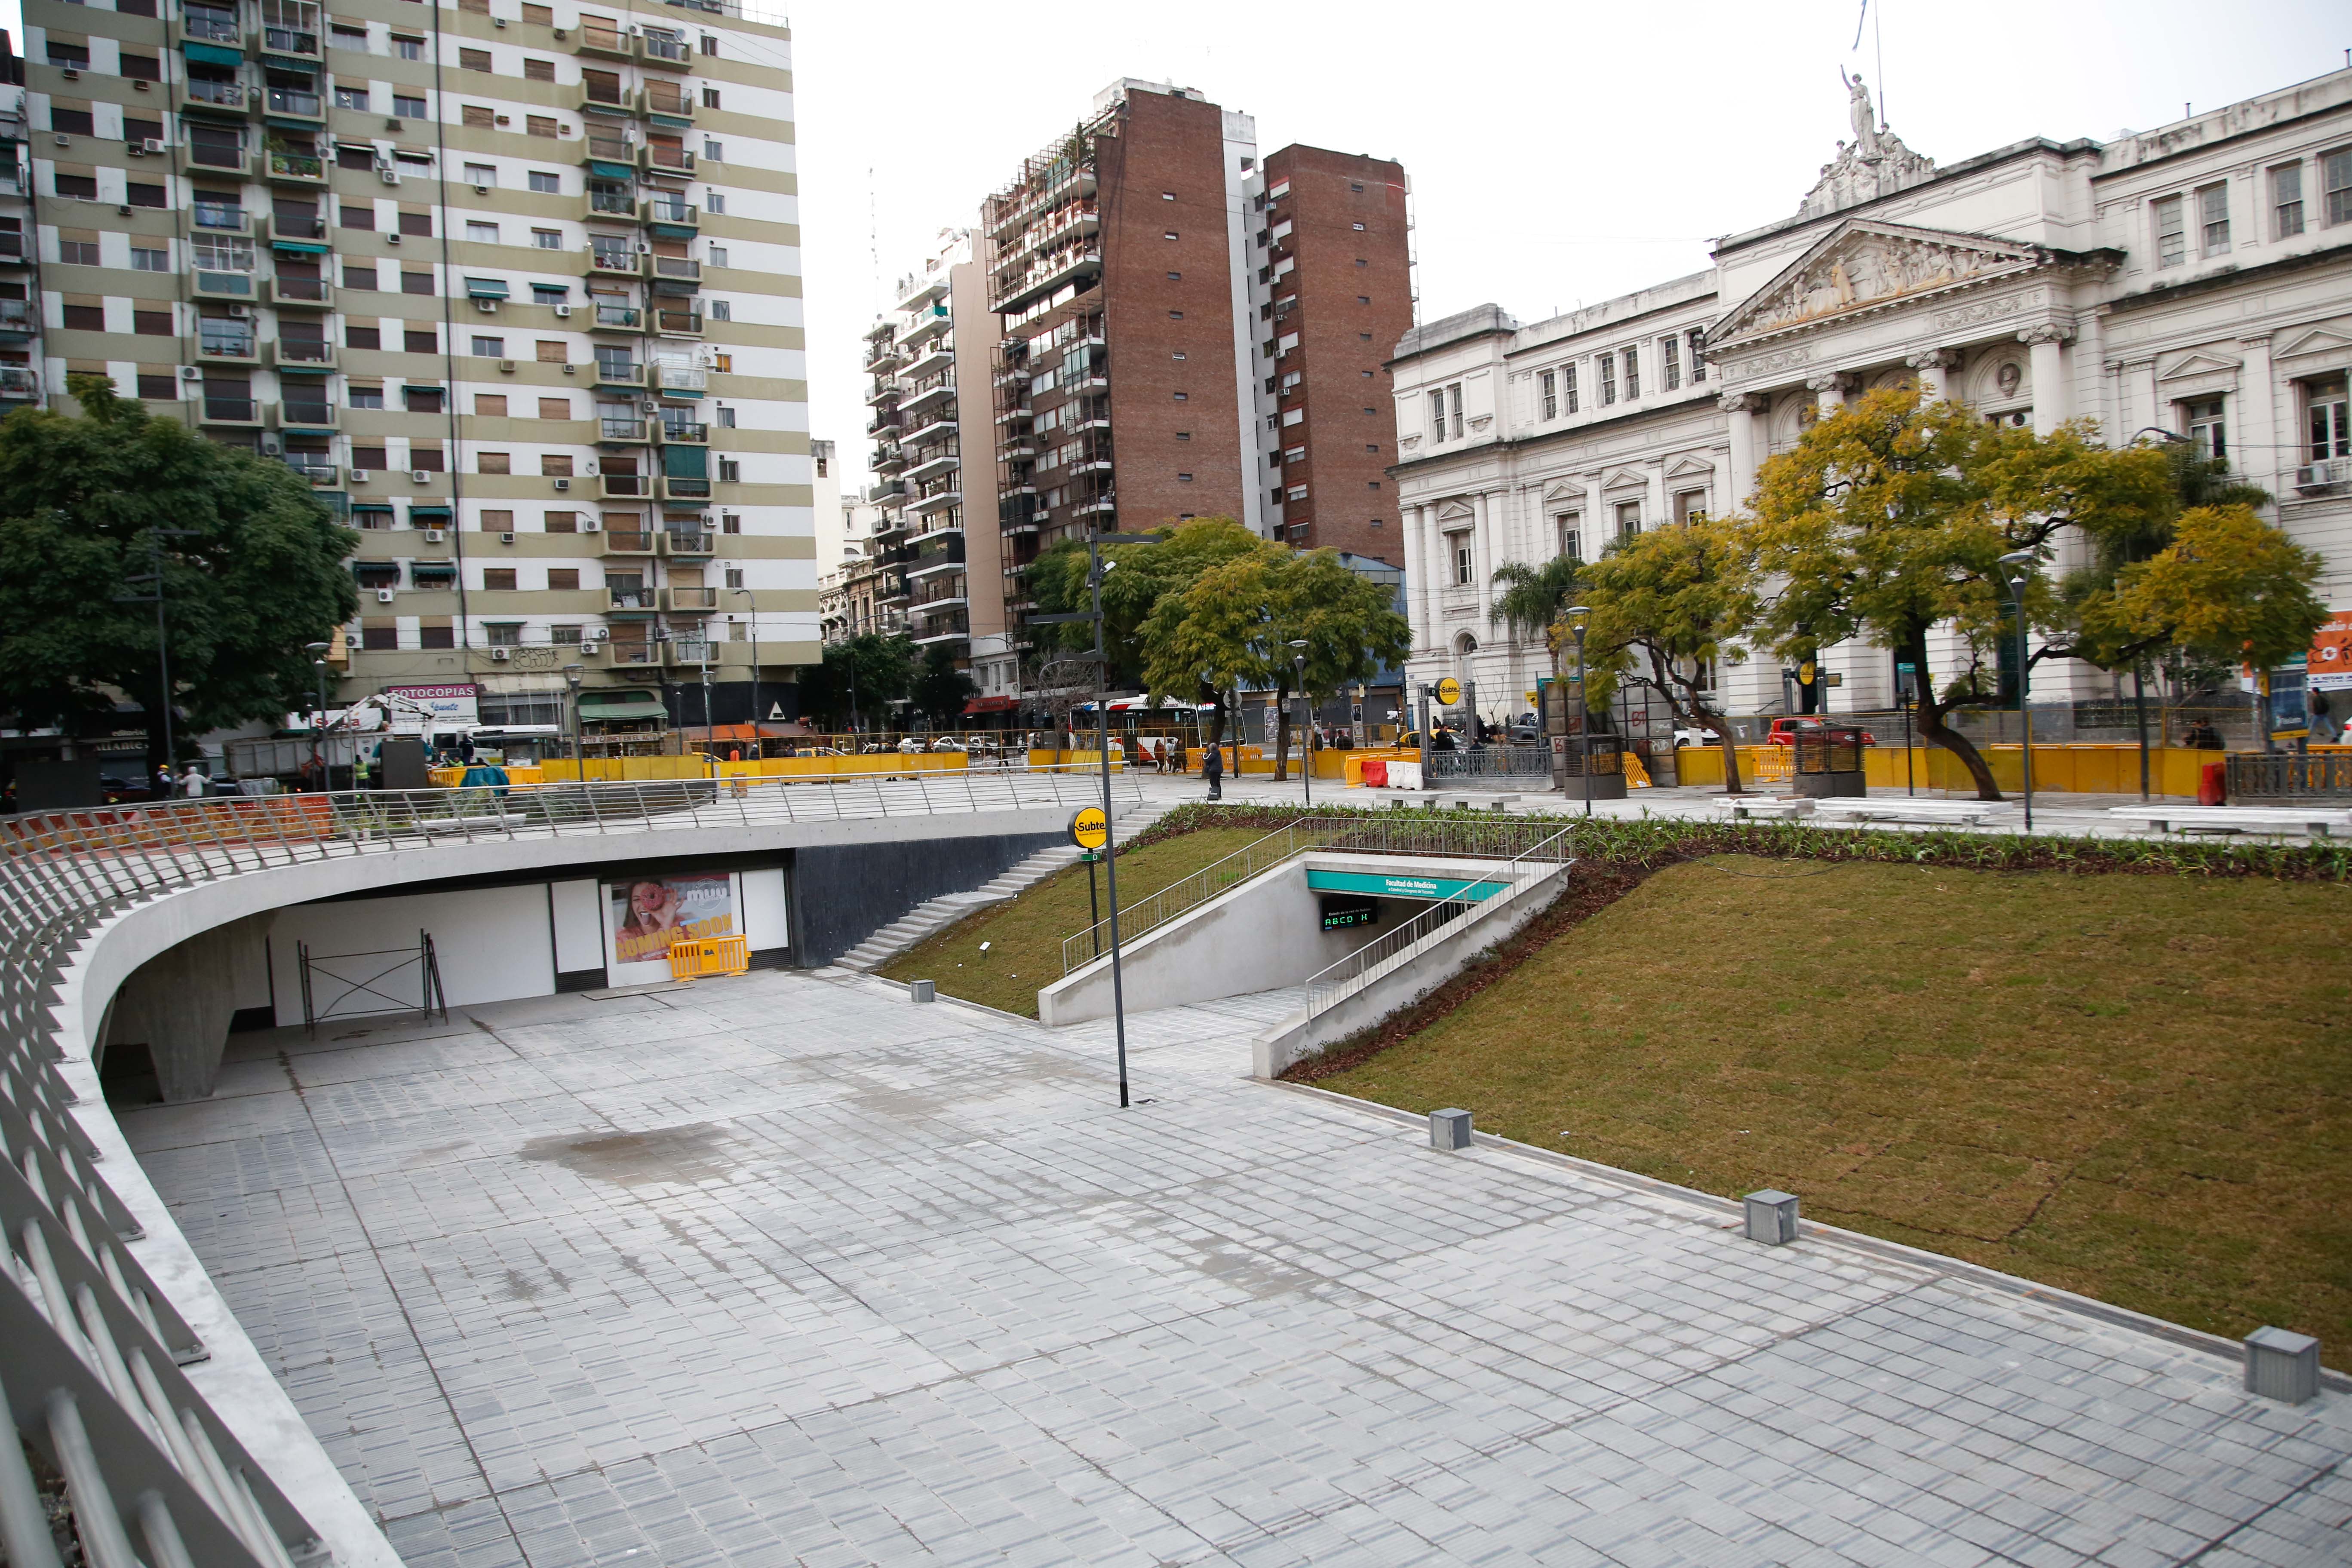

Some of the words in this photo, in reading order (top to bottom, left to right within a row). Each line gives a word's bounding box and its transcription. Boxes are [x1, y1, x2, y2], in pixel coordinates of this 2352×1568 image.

[391, 687, 475, 698] FOTOCOPIAS
[1077, 822, 1105, 831] Subte
[616, 926, 685, 960] COMING
[687, 914, 732, 939] SOON
